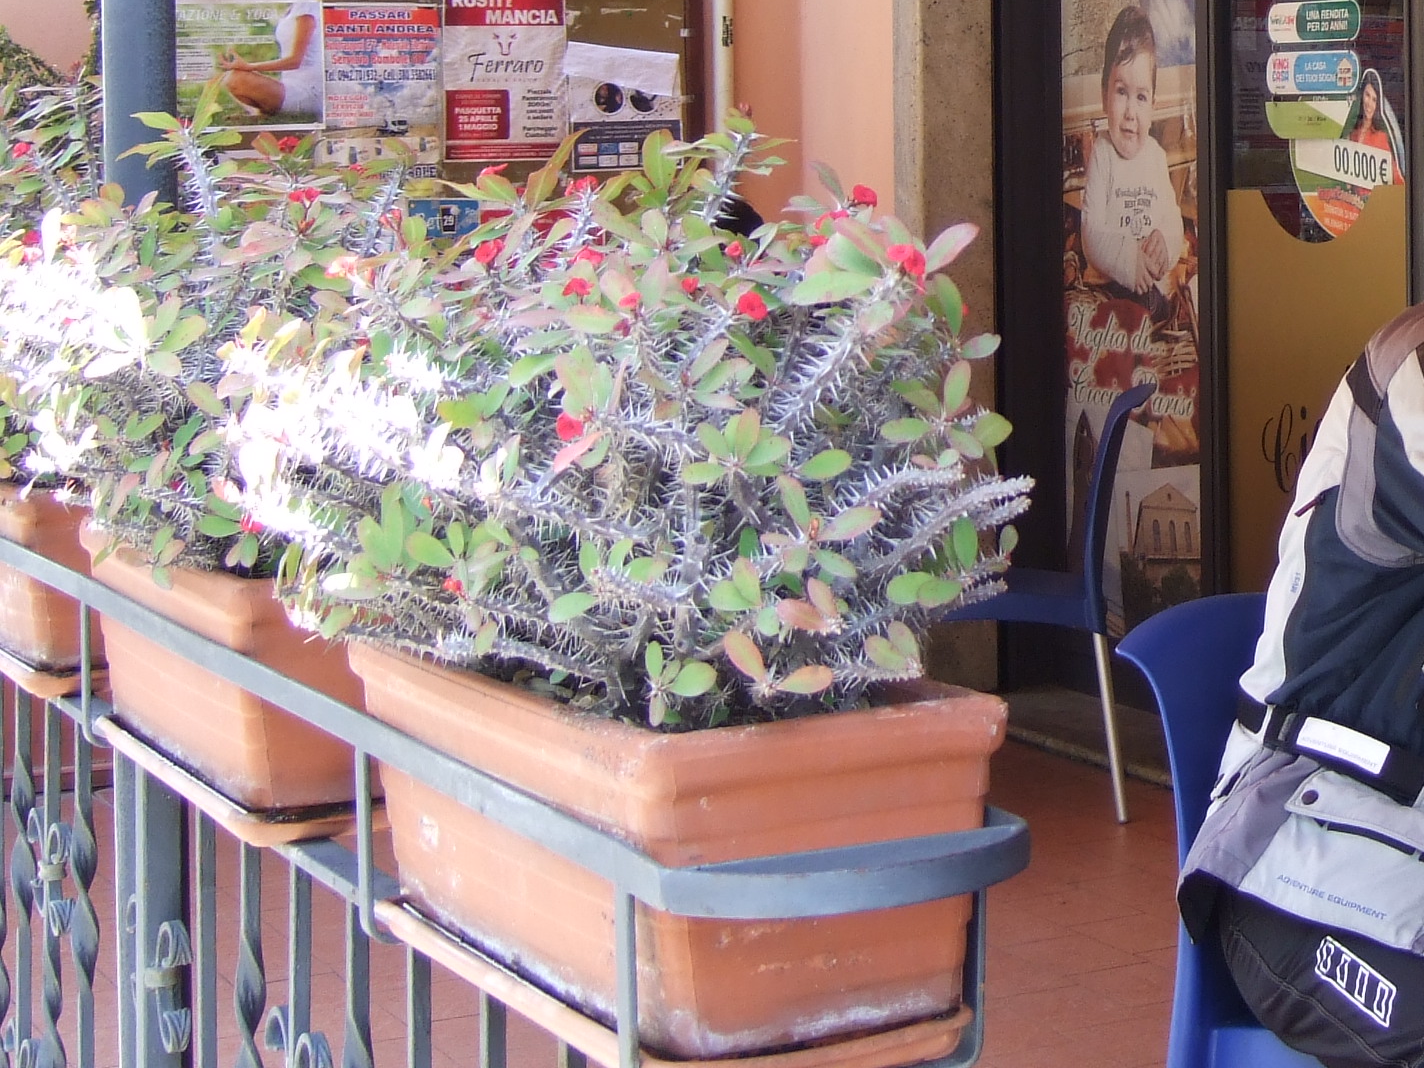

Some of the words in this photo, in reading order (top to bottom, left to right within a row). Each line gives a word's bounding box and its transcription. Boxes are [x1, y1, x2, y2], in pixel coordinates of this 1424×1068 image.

[348, 10, 412, 20] PASSARI
[485, 9, 559, 24] MANCIA
[1306, 9, 1320, 20] UNA
[1321, 8, 1350, 20] RENDITA
[326, 24, 371, 34] SANTI
[375, 24, 434, 34] ANDREA
[1306, 22, 1320, 31] PER
[467, 52, 545, 83] Ferraro
[455, 106, 502, 114] PASQUETTA
[1070, 303, 1127, 362] Voglia
[1277, 873, 1325, 899] ADVENTURE
[1327, 894, 1387, 920] EQUIPMENT
